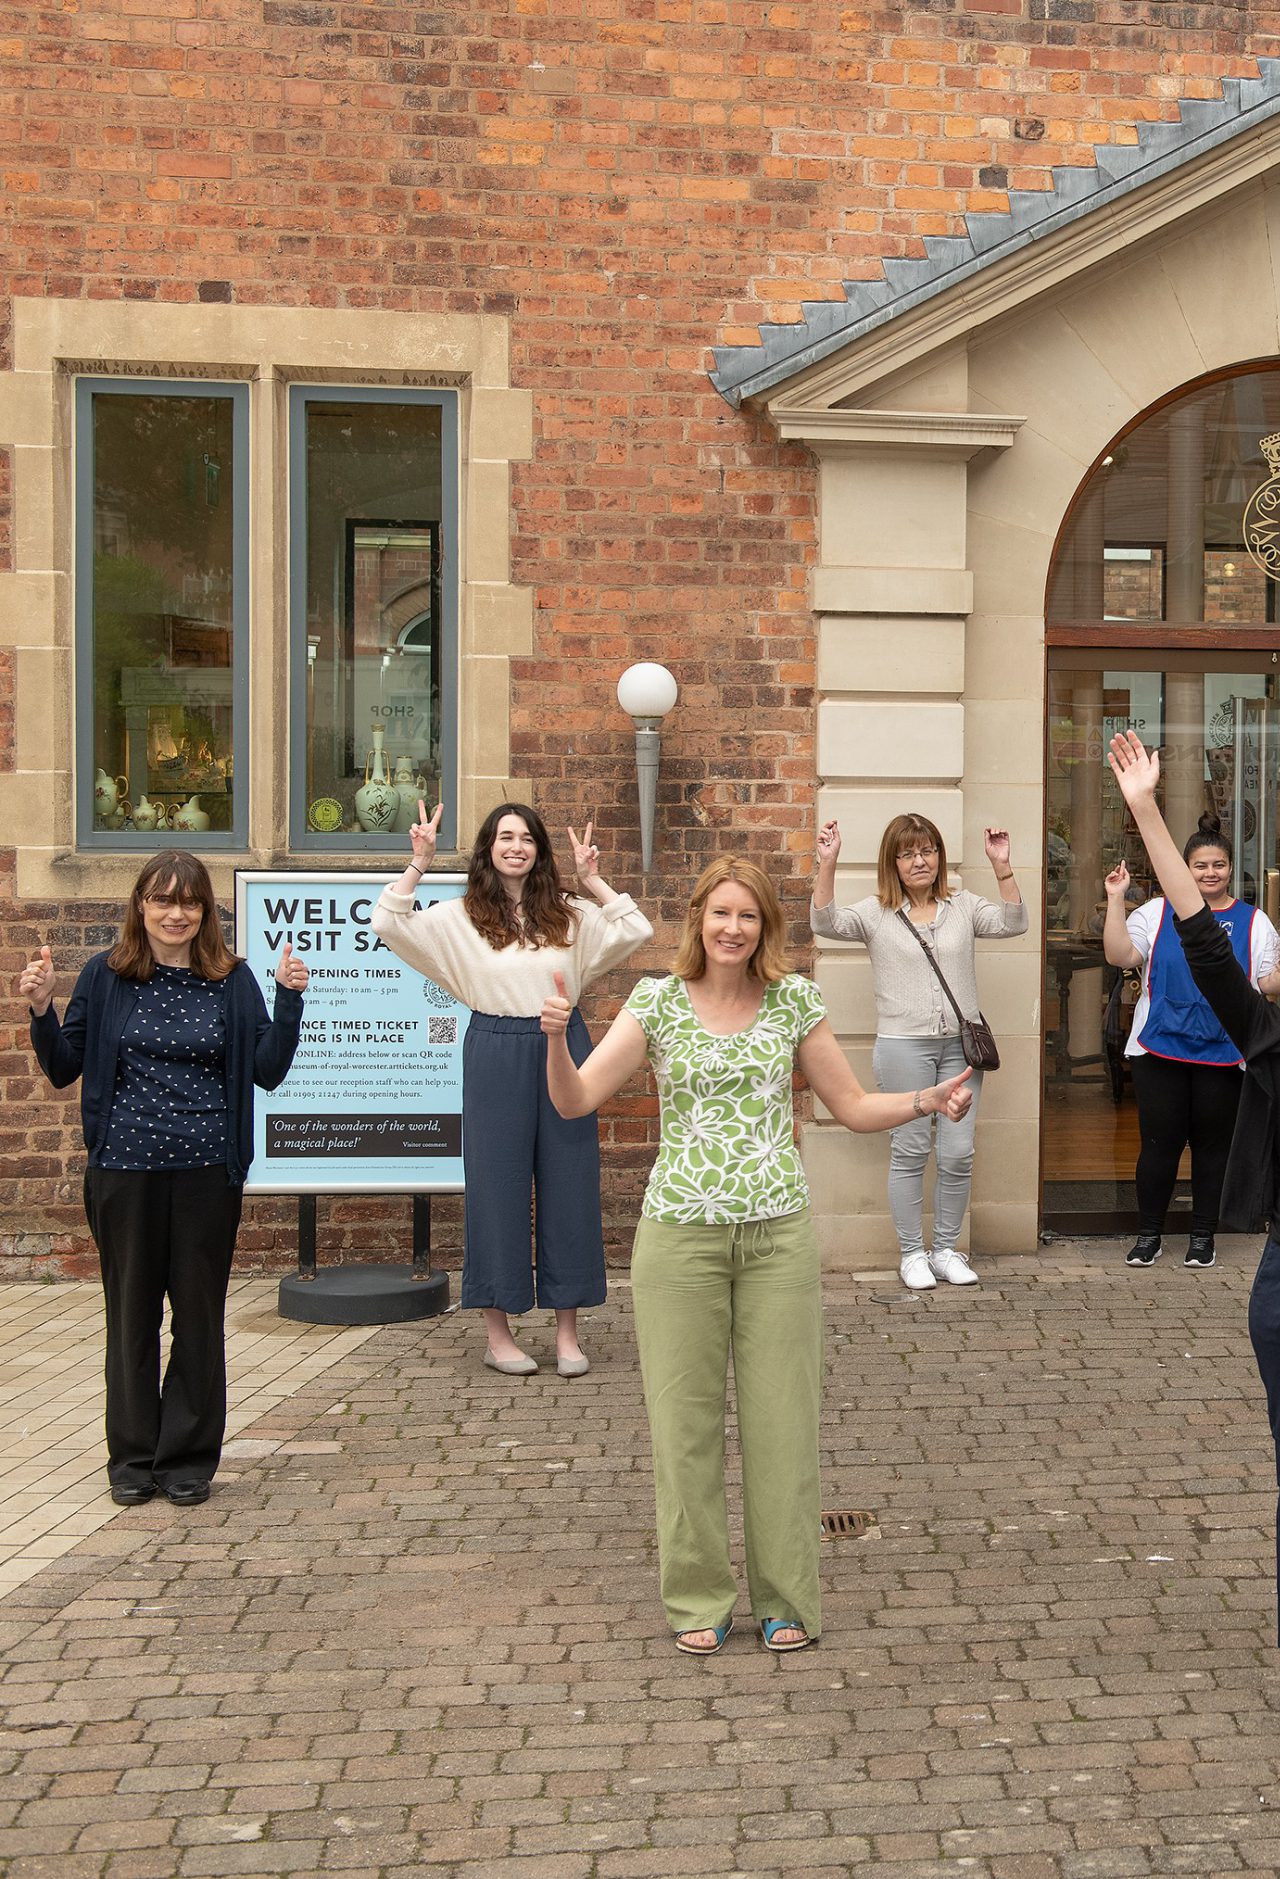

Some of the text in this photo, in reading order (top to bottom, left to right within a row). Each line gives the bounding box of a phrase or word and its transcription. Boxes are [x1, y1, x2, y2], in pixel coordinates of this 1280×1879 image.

[263, 930, 342, 952] VISIT
[307, 969, 401, 979] PENING TIMES
[313, 985, 348, 996] Saturday:
[331, 1021, 371, 1030] TIMED
[375, 1021, 419, 1030] TICKET
[331, 1034, 342, 1043] IS
[347, 1034, 361, 1043] IN
[366, 1034, 405, 1043] PLACE
[295, 1050, 336, 1058] ONLINE:
[338, 1050, 366, 1058] address
[368, 1050, 390, 1058] below
[419, 1050, 434, 1059] QR
[435, 1050, 453, 1058] code
[339, 1079, 374, 1087] reception
[375, 1078, 392, 1086] staff
[425, 1079, 441, 1087] help
[442, 1080, 459, 1088] you.
[265, 1090, 276, 1098] Or
[278, 1090, 291, 1098] call
[293, 1091, 316, 1099] 01905
[342, 1090, 367, 1099] during
[368, 1091, 399, 1099] opening
[400, 1090, 423, 1098] hours.
[299, 1120, 312, 1134] of
[312, 1120, 328, 1131] the
[331, 1120, 374, 1131] wonders
[376, 1120, 389, 1134] of
[389, 1120, 405, 1131] the
[407, 1120, 441, 1132] world,
[273, 1140, 281, 1148] a
[284, 1137, 325, 1151] magical
